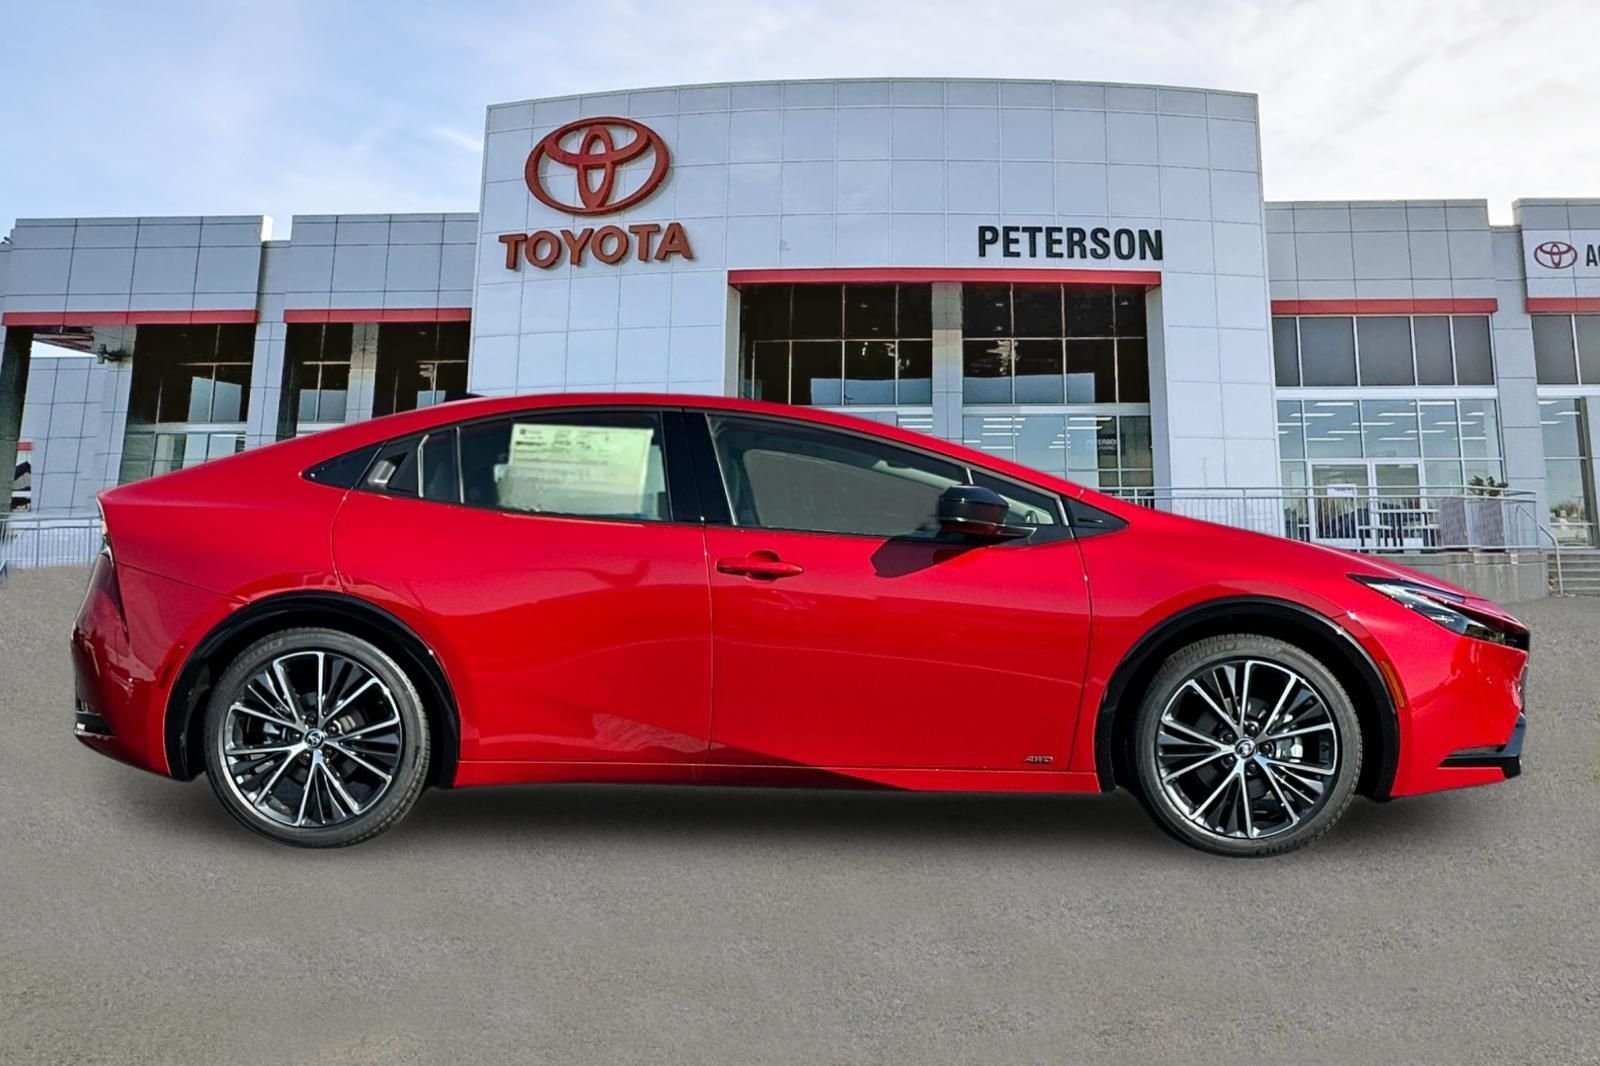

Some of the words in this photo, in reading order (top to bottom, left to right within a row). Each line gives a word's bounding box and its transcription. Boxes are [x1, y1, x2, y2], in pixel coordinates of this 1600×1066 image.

[498, 222, 694, 270] TOYOTA
[978, 225, 1164, 261] PETERSON
[1585, 244, 1600, 267] A
